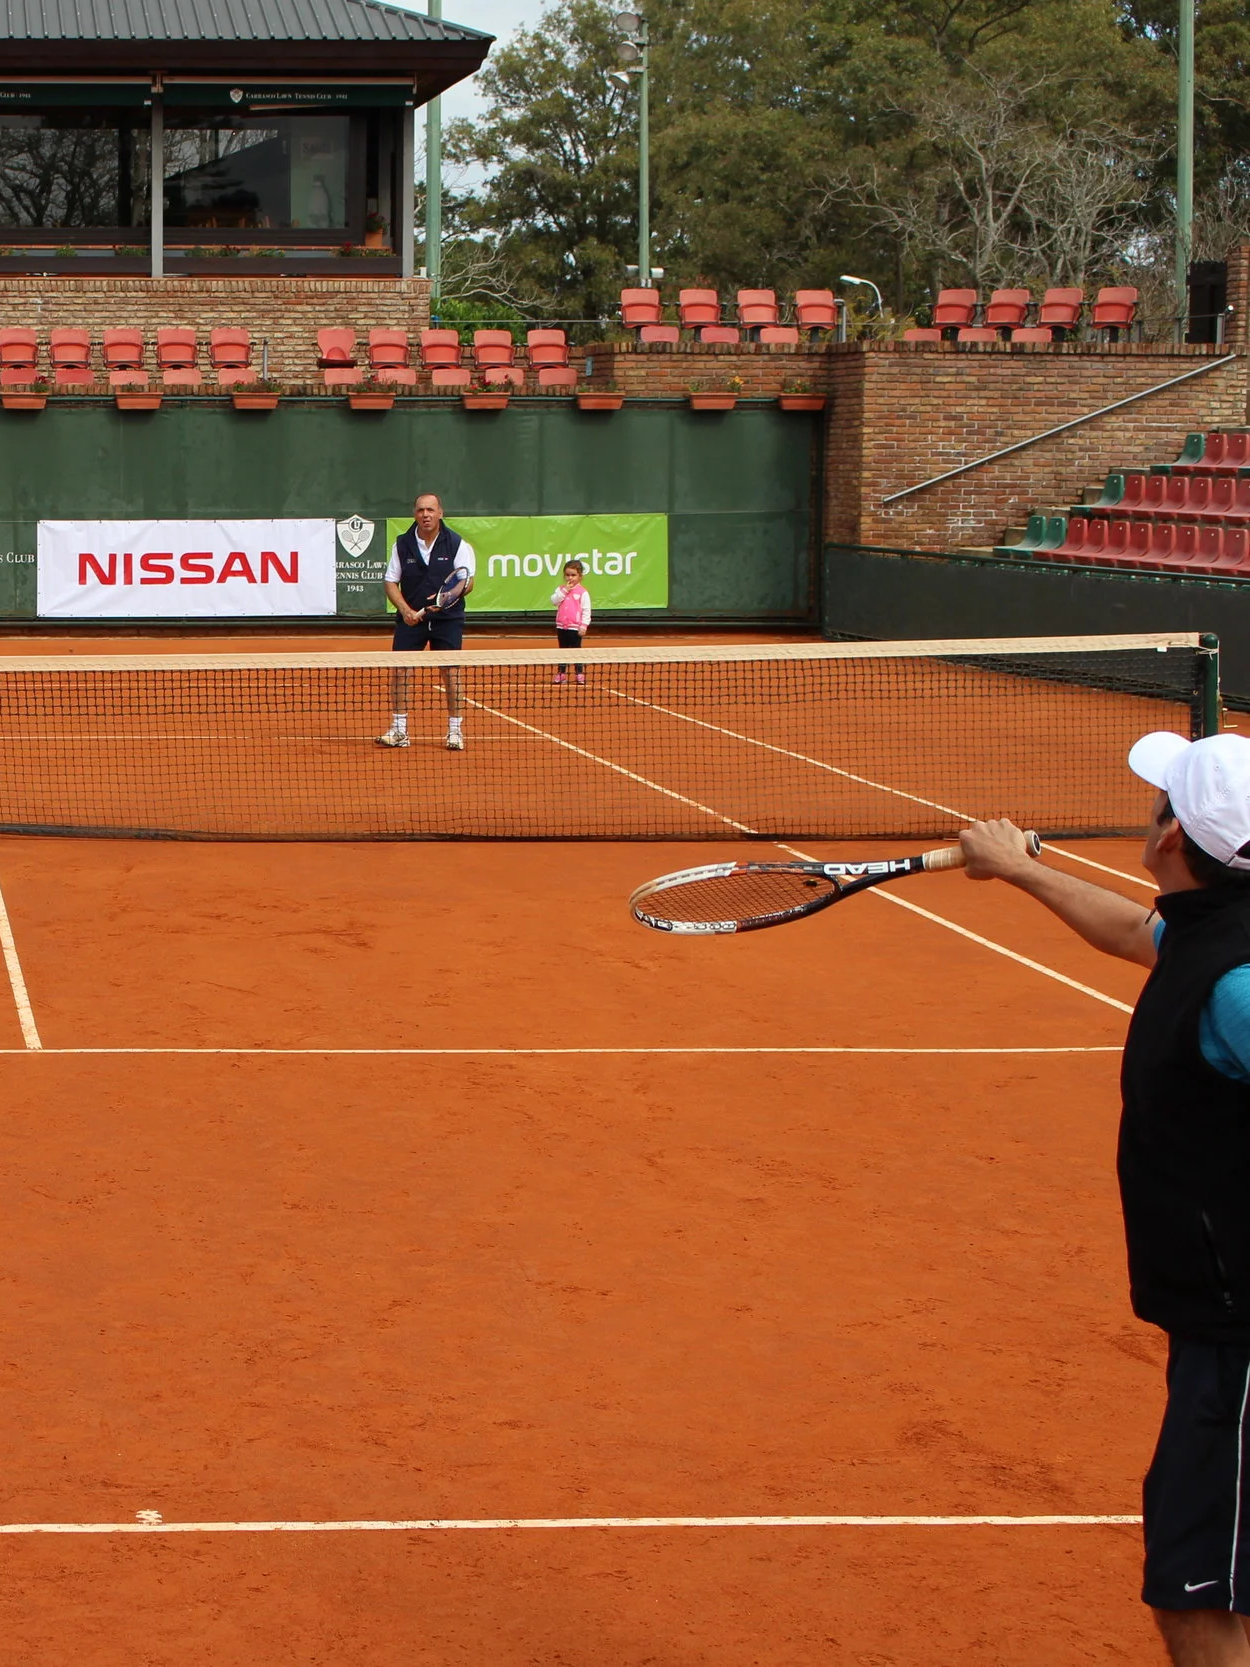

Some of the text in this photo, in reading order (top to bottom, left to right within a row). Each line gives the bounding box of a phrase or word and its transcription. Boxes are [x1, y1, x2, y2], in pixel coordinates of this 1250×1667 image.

[6, 551, 36, 564] CLUB
[78, 551, 299, 586] NISSAN
[335, 570, 383, 580] ENNIS CLUB
[346, 584, 364, 593] 1943
[823, 858, 911, 875] HEAD
